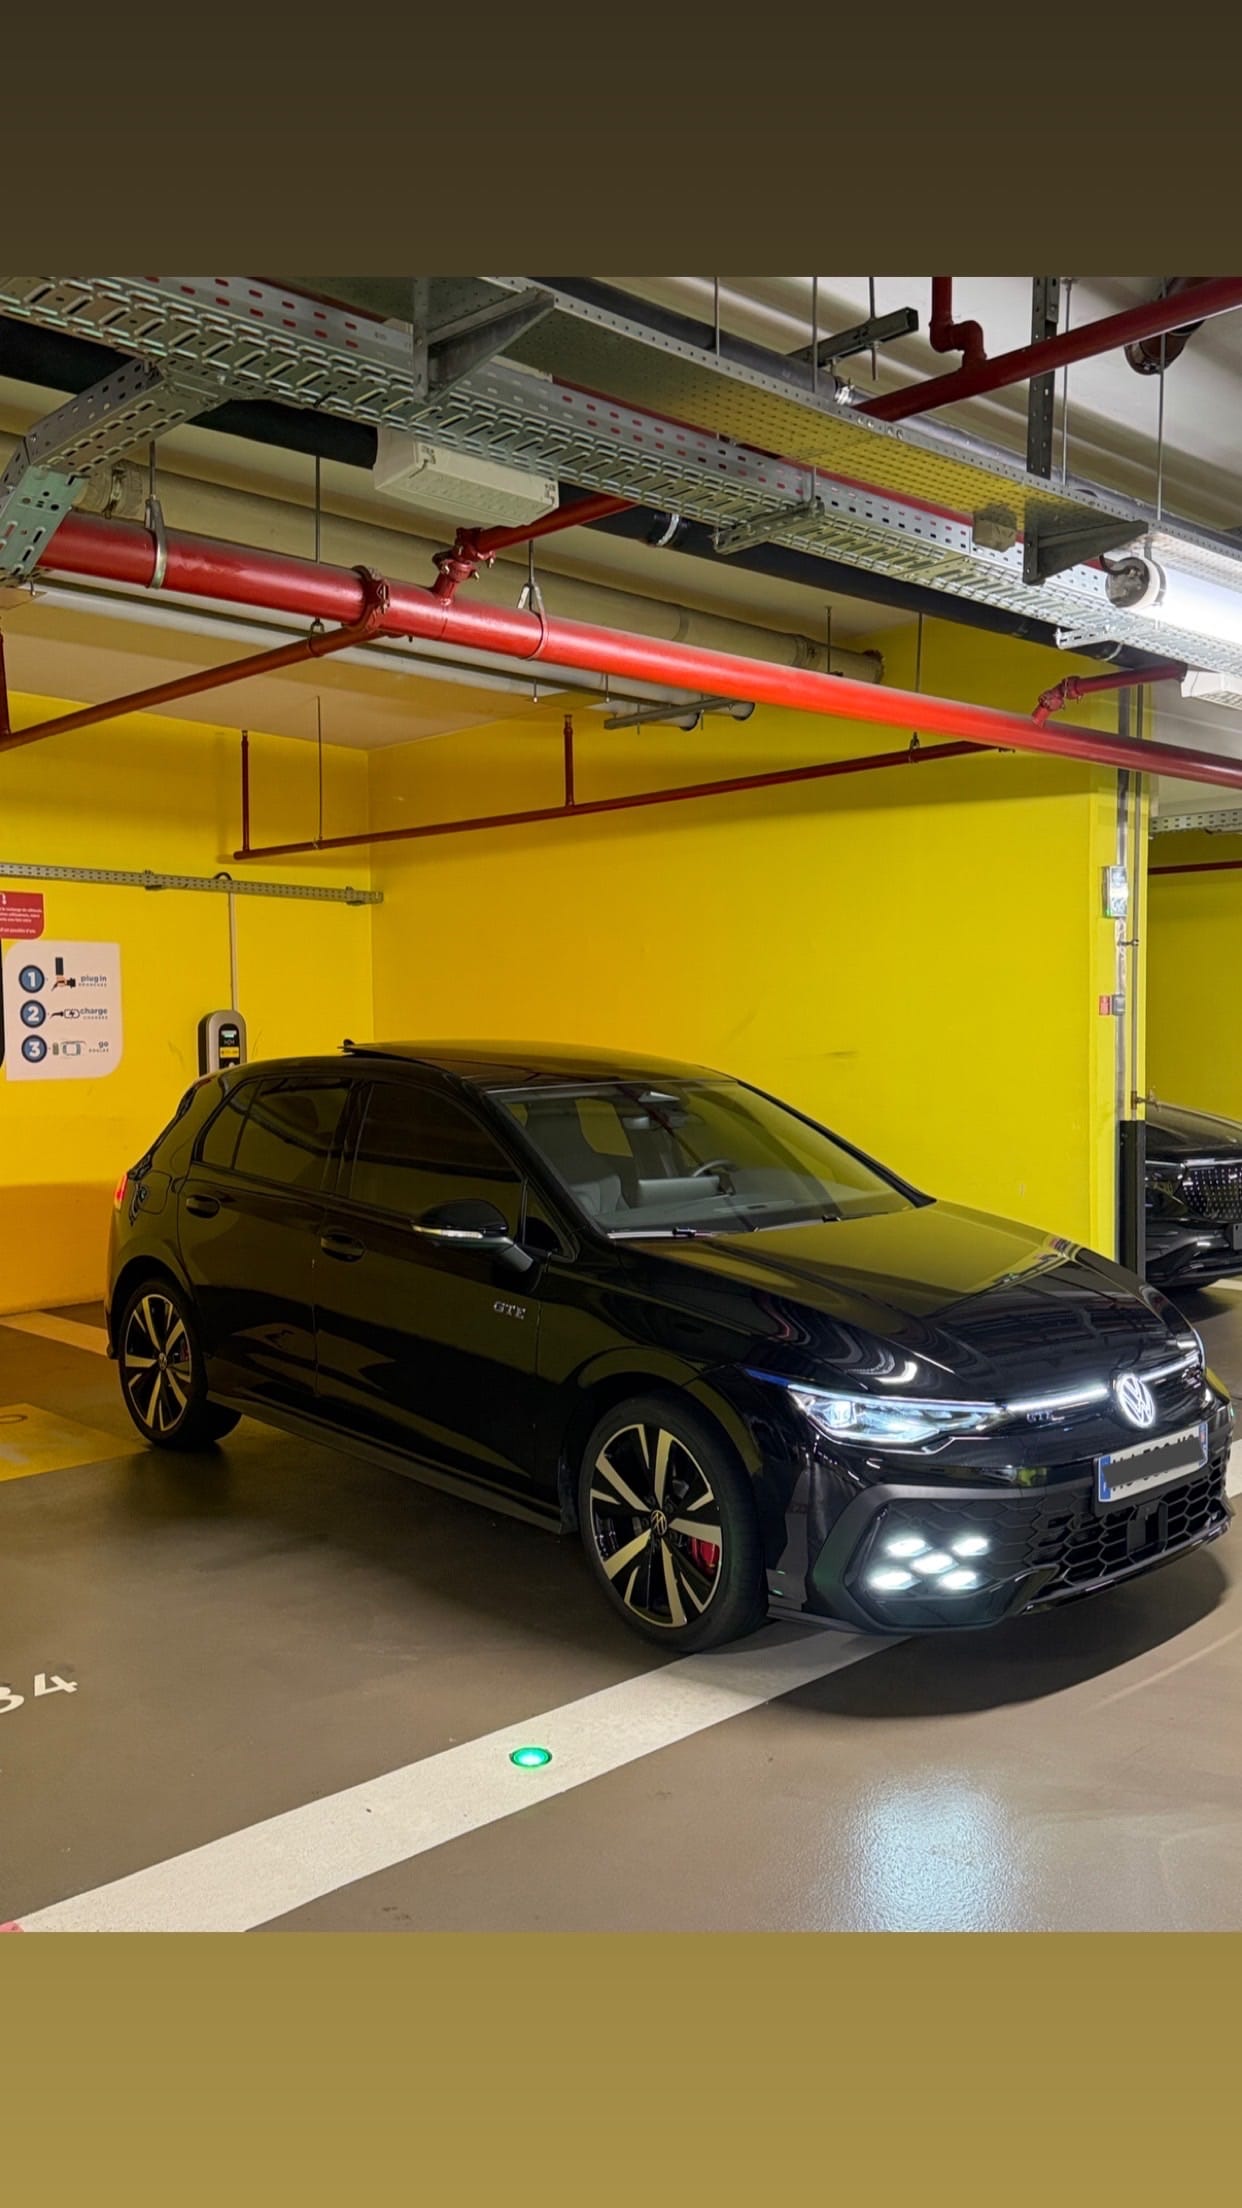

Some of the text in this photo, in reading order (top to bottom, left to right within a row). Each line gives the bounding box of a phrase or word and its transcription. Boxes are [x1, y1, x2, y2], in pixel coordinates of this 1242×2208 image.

[27, 971, 37, 988] 1
[27, 1005, 40, 1022] 2
[29, 1041, 41, 1057] 3
[493, 1300, 527, 1320] GTE
